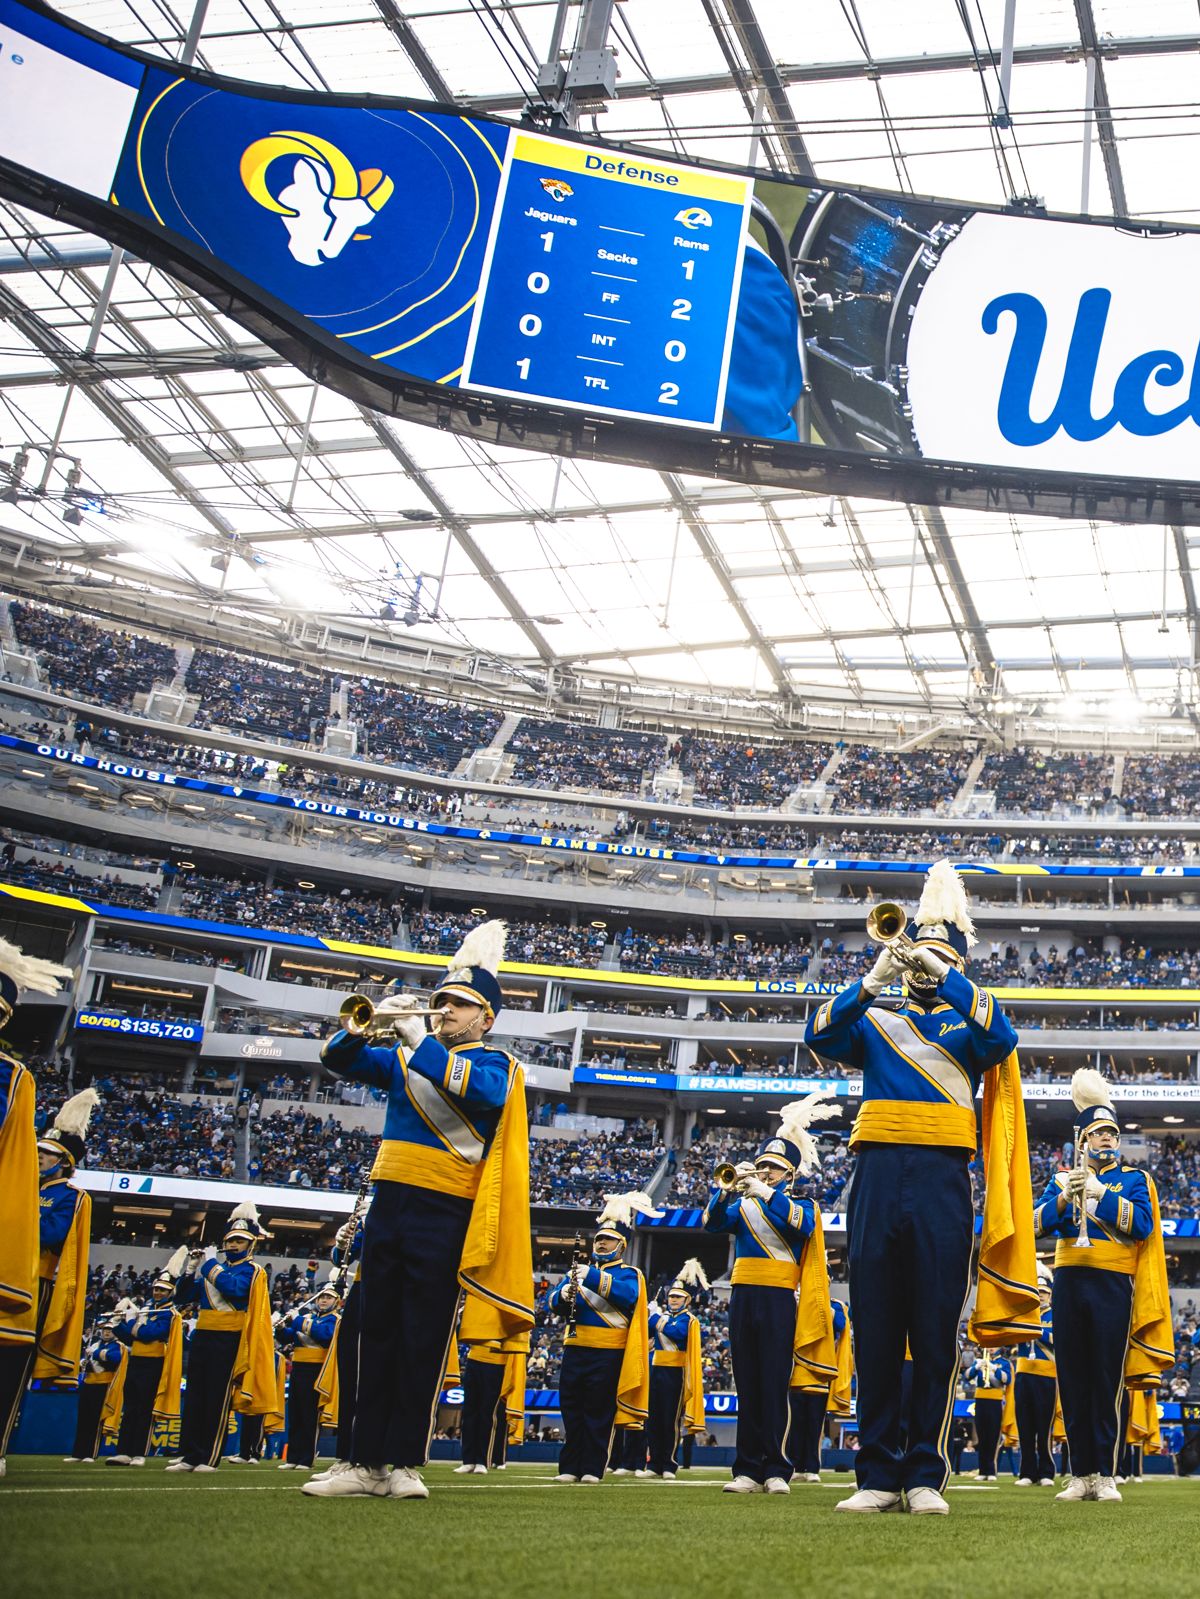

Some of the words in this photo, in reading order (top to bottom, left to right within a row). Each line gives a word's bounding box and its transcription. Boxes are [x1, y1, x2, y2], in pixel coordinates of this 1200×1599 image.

[585, 155, 679, 186] Defense
[524, 207, 577, 226] Jaguars
[674, 236, 709, 251] Rams
[540, 232, 554, 252] 1
[597, 249, 638, 265] Sacks
[682, 260, 695, 280] 1
[527, 271, 550, 294] 0
[602, 292, 620, 304] FF
[671, 299, 692, 321] 2
[519, 314, 542, 336] 0
[591, 333, 616, 347] INT
[664, 340, 686, 362] 0
[516, 357, 531, 380] 1
[584, 376, 609, 390] TFL
[658, 382, 680, 405] 2
[37, 745, 86, 764] OUR
[98, 760, 177, 784] HOUSE
[292, 798, 348, 816] YOUR
[358, 811, 429, 832] HOUSE
[541, 836, 597, 851] RAMS
[608, 844, 674, 860] HOUSE
[755, 980, 797, 993] LOS
[79, 1014, 120, 1028] 50/50
[120, 1017, 194, 1039] $135,720
[240, 1043, 282, 1057] Corona
[689, 1078, 821, 1092] #RAMSHOUSE
[1026, 1088, 1051, 1097] sick,
[1123, 1089, 1138, 1097] for
[1142, 1089, 1159, 1097] the
[119, 1178, 130, 1189] 8
